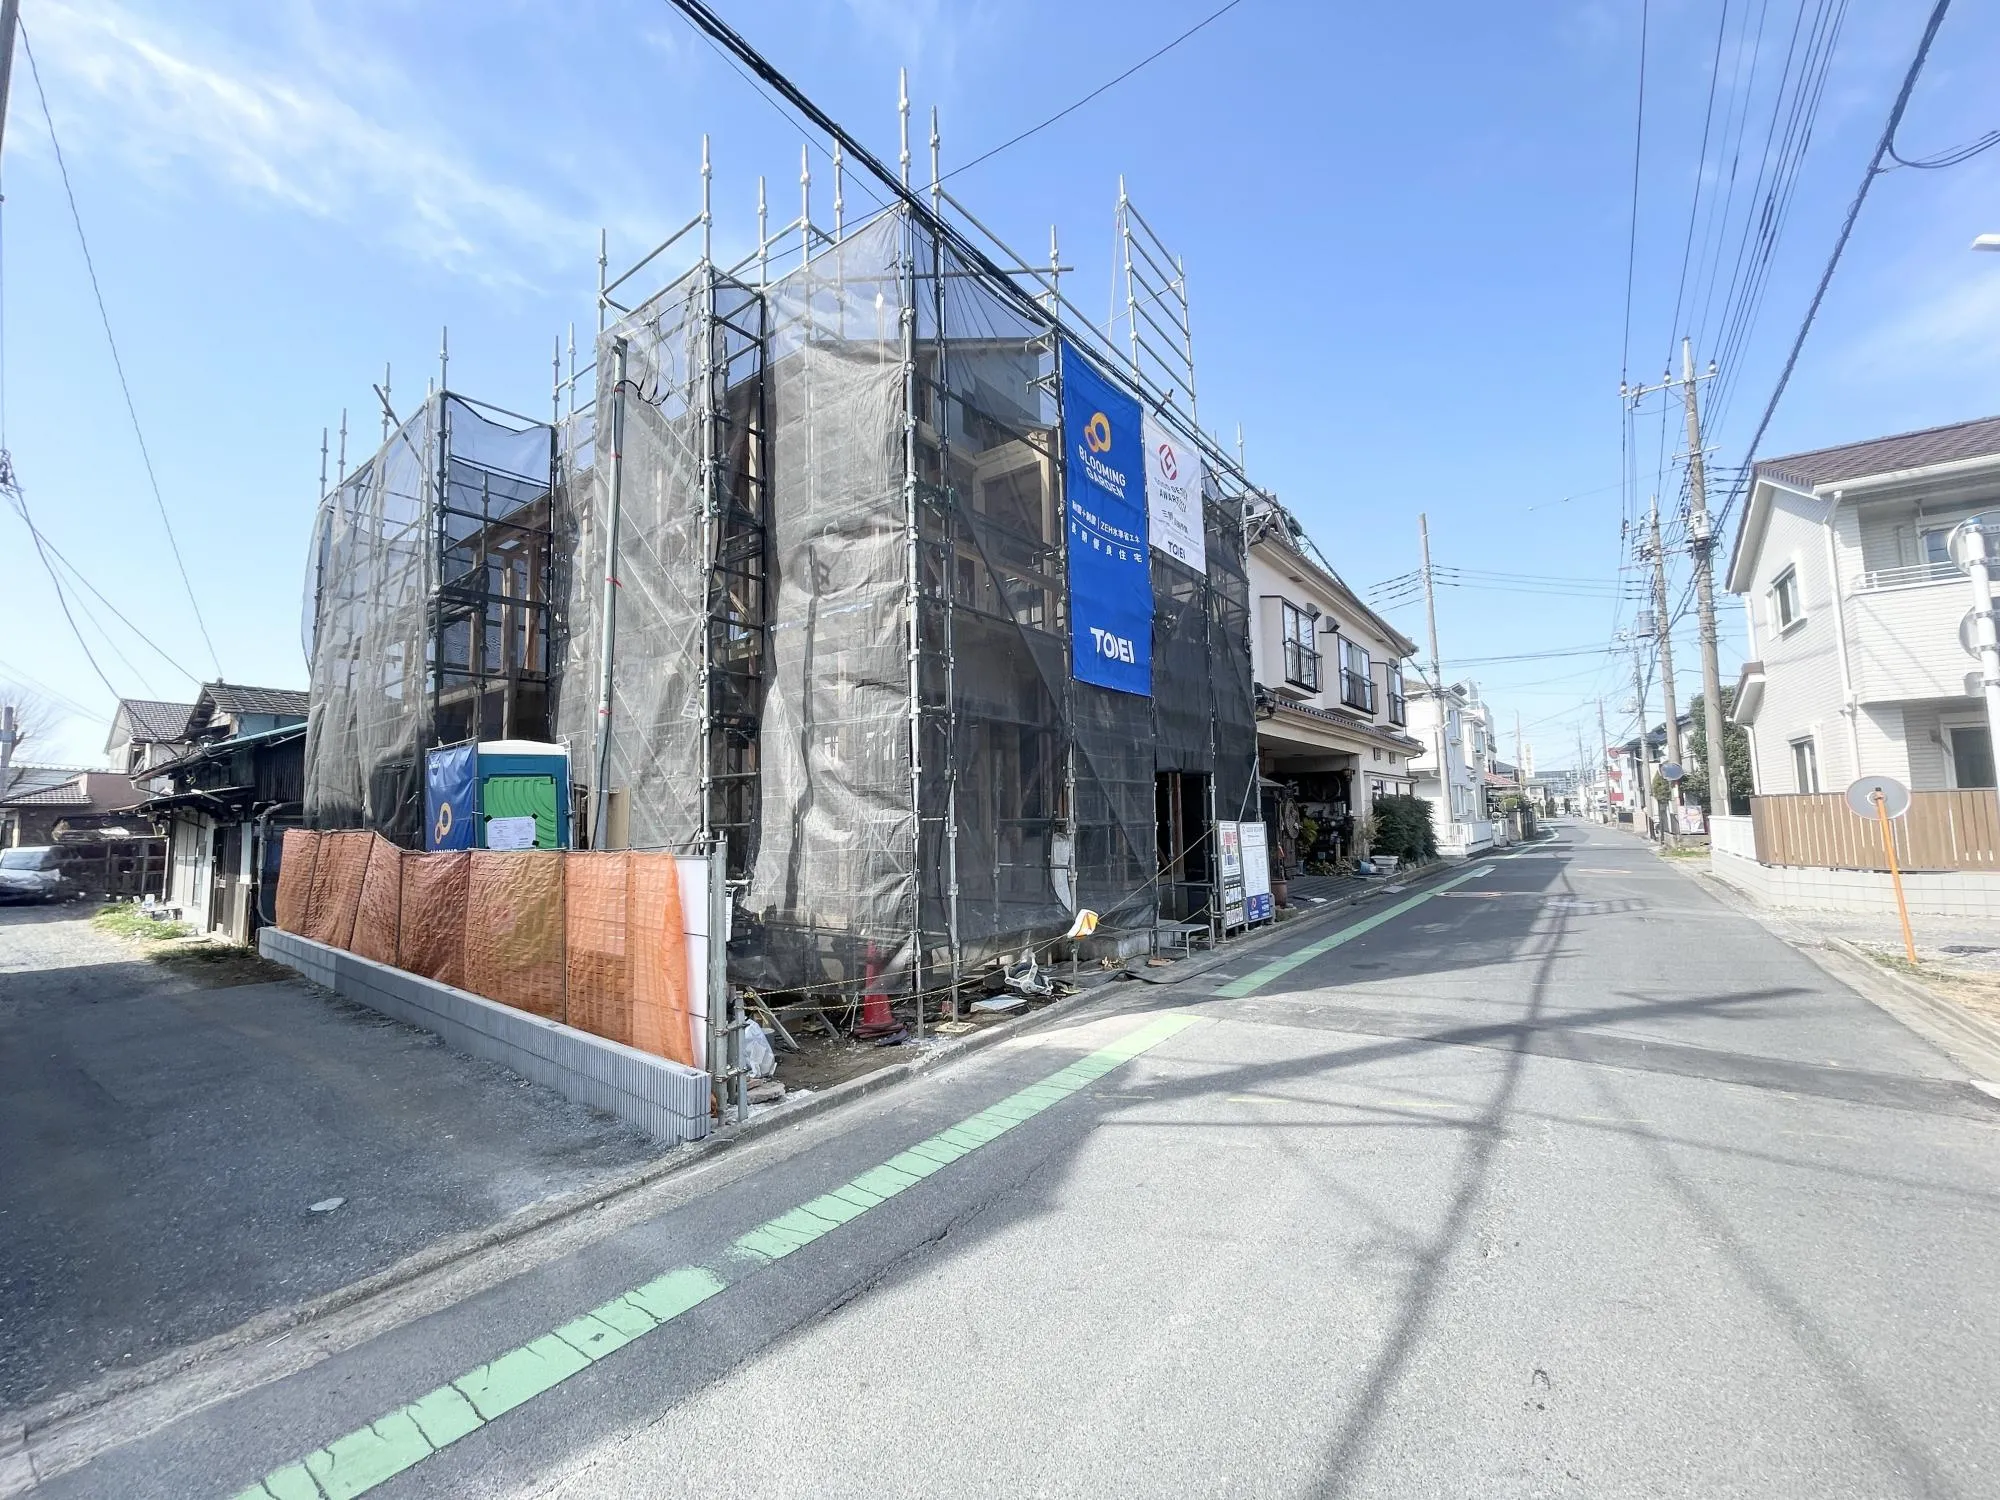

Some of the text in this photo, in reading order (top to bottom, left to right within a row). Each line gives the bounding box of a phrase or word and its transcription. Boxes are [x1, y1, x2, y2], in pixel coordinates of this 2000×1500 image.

[1078, 444, 1126, 487] BLOOMING
[1085, 467, 1125, 499] GARDEN
[1167, 540, 1187, 560] TOEI
[1090, 626, 1135, 664] TOEI
